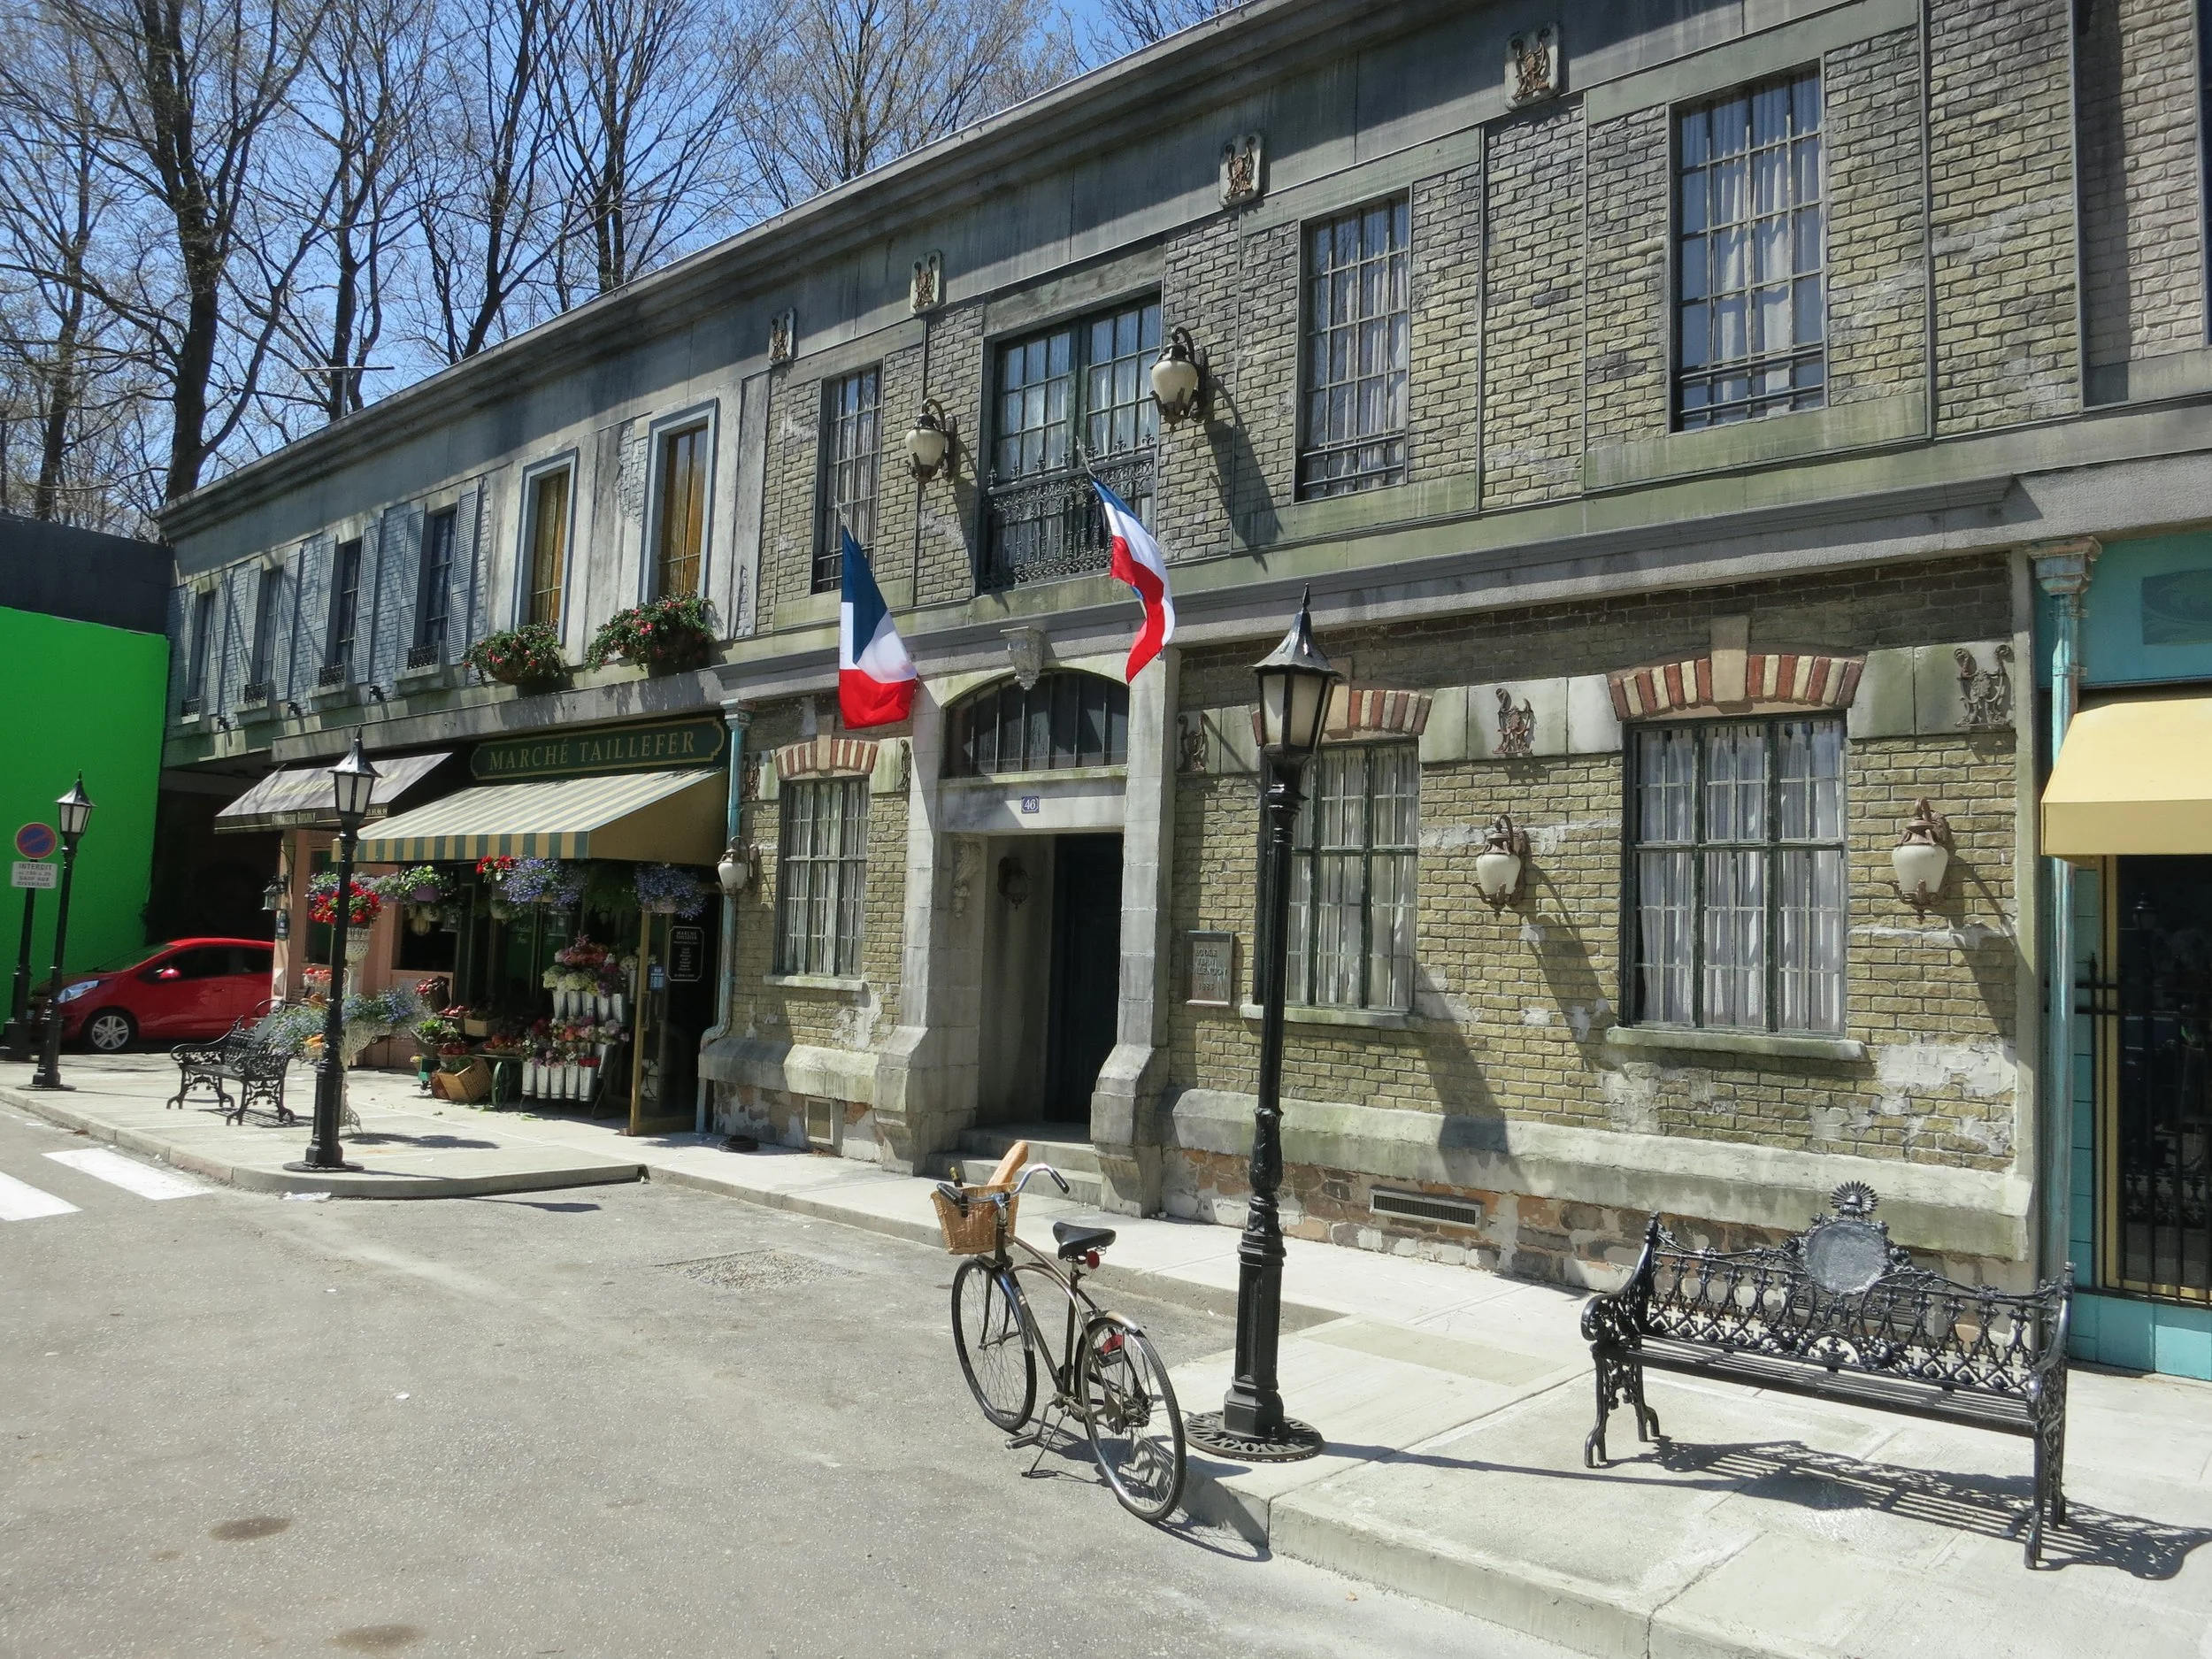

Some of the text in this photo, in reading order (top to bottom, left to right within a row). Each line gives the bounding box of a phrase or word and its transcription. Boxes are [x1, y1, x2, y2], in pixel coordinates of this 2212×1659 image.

[488, 731, 695, 771] MARCHÉ TAILLEFER
[1024, 799, 1036, 810] 46
